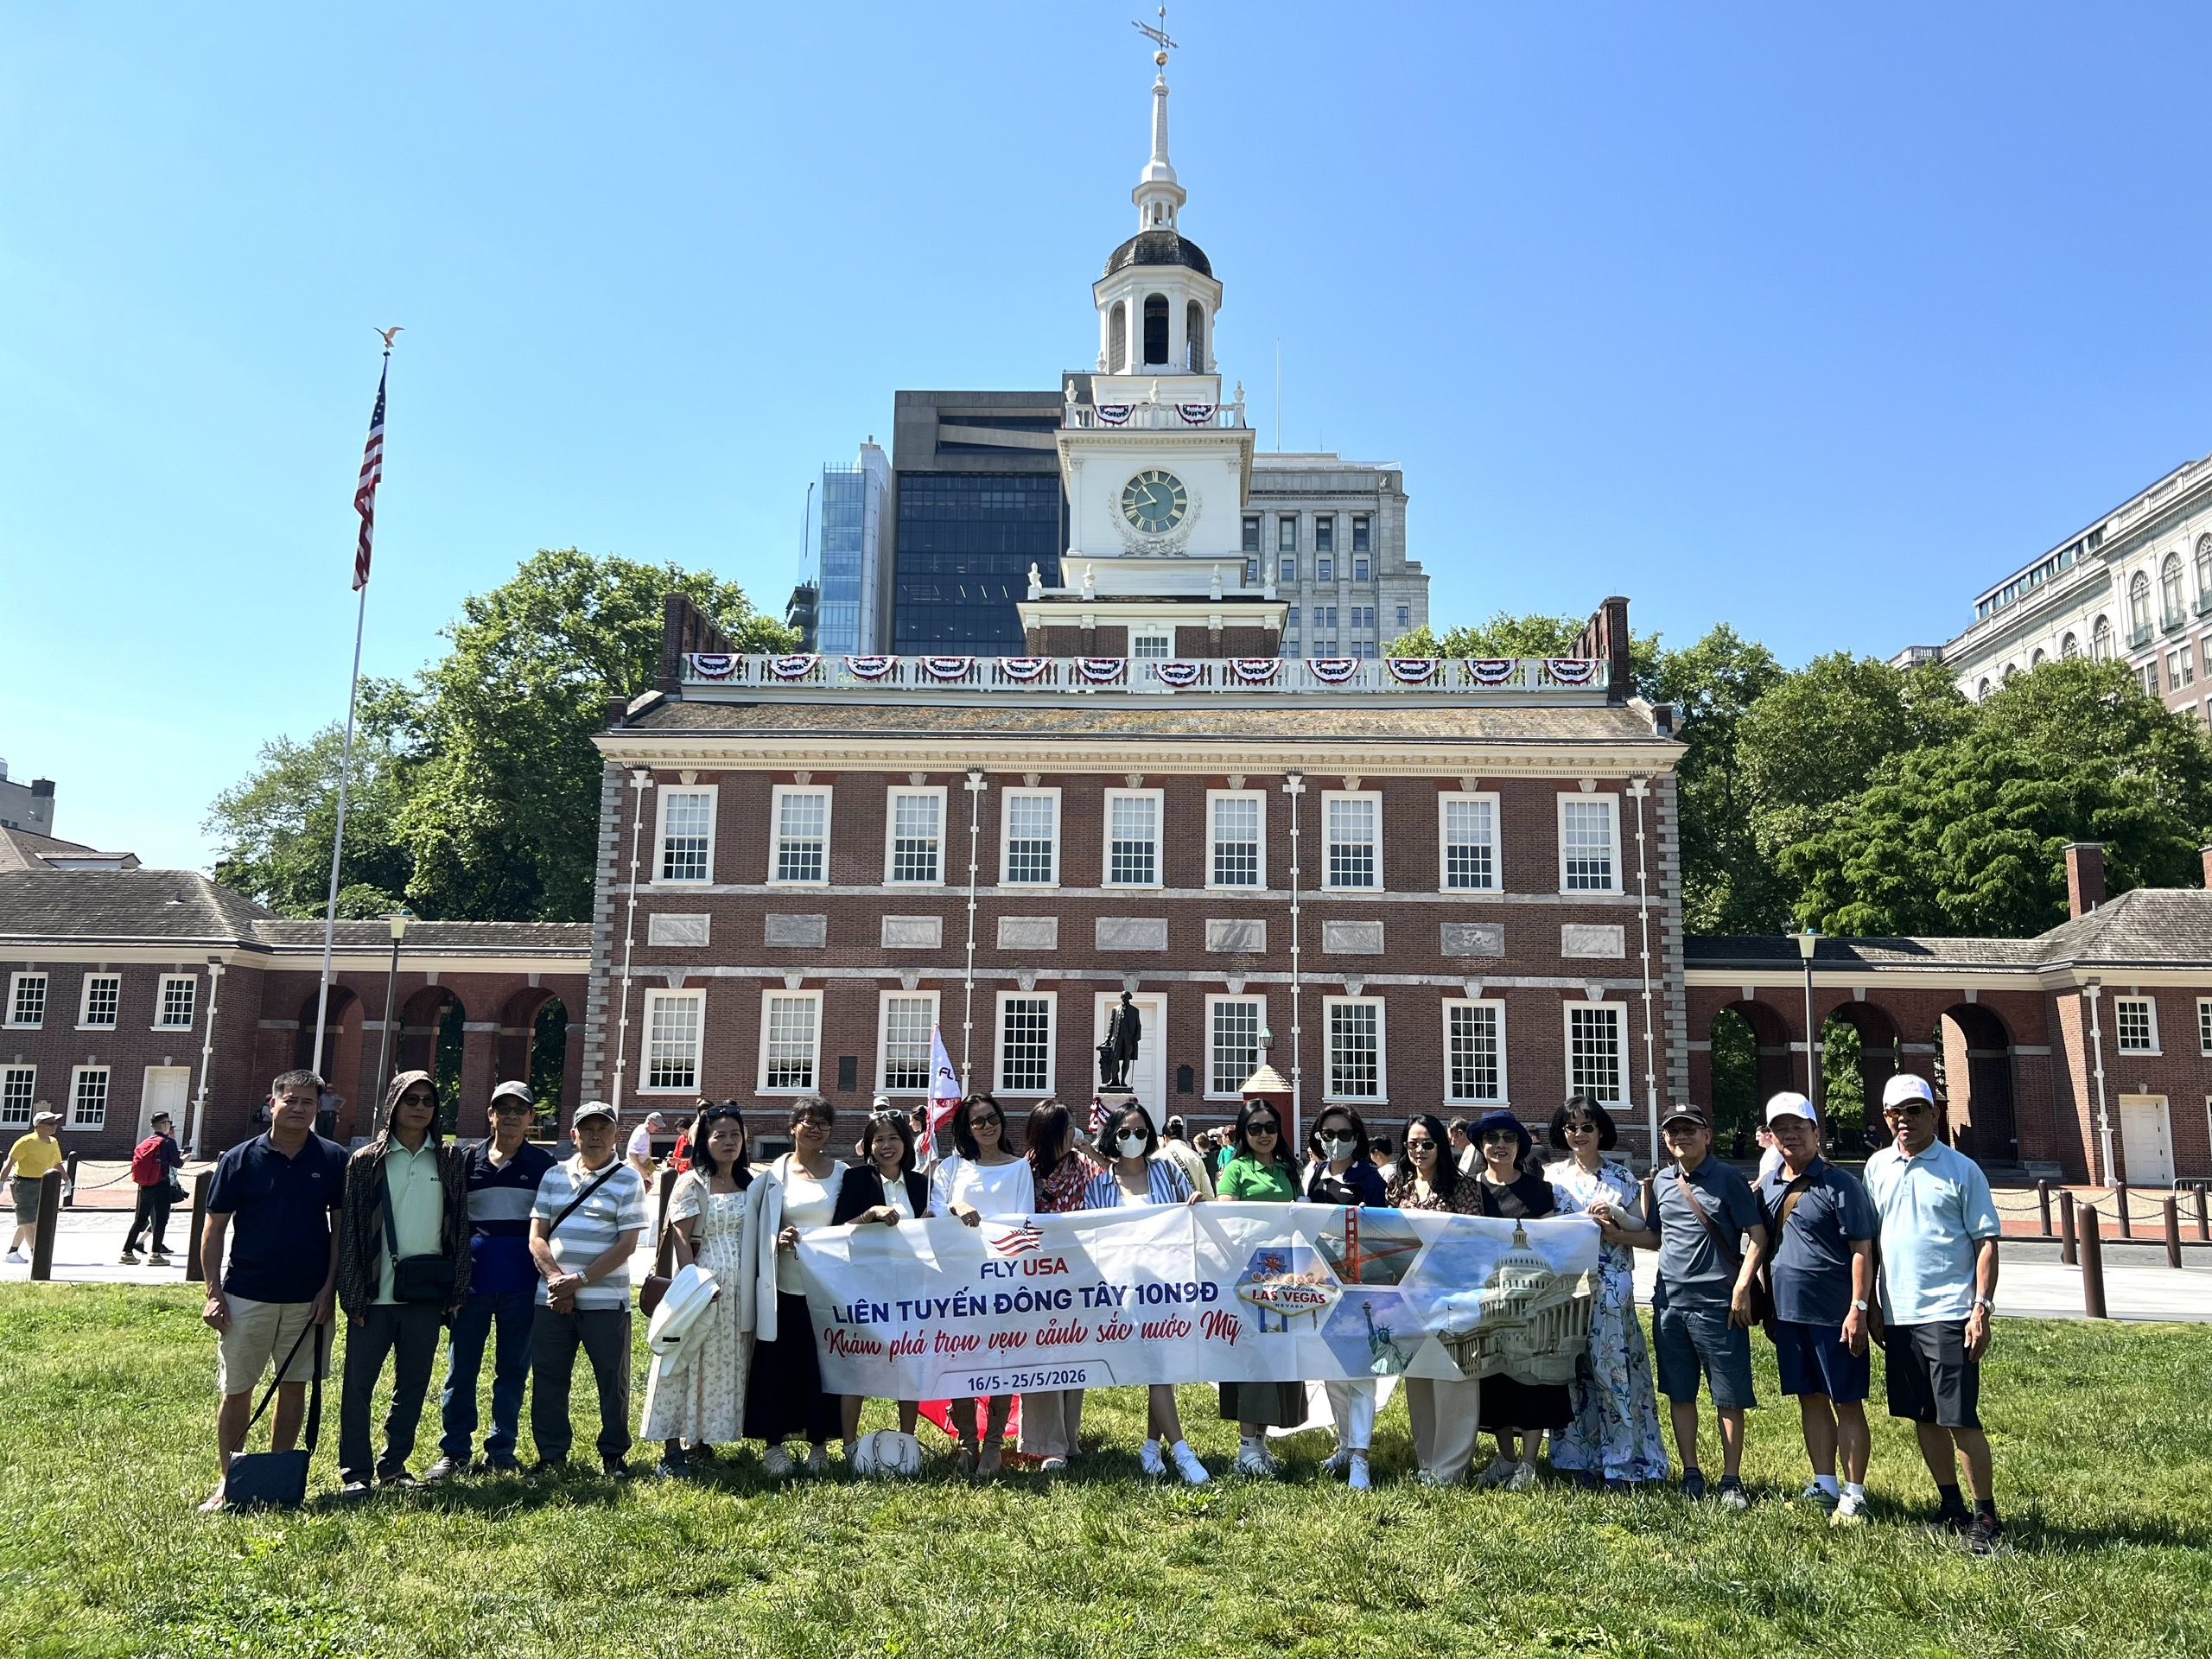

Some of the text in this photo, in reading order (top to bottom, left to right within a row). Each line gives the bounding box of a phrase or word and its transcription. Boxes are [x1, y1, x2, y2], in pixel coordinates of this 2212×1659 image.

[938, 1067, 957, 1081] FL
[981, 1257, 1069, 1279] FLY USA
[832, 1281, 1218, 1324] LIÊN TUYẾN ĐÔNG TÂY 10N9Đ
[1252, 1289, 1326, 1304] LAS VEGAS
[823, 1308, 1243, 1363] Khám phá trọn vẹn cảnh sắc nước Mỹ
[968, 1376, 1001, 1391] 16/5
[1012, 1369, 1086, 1388] 25/5/2026
